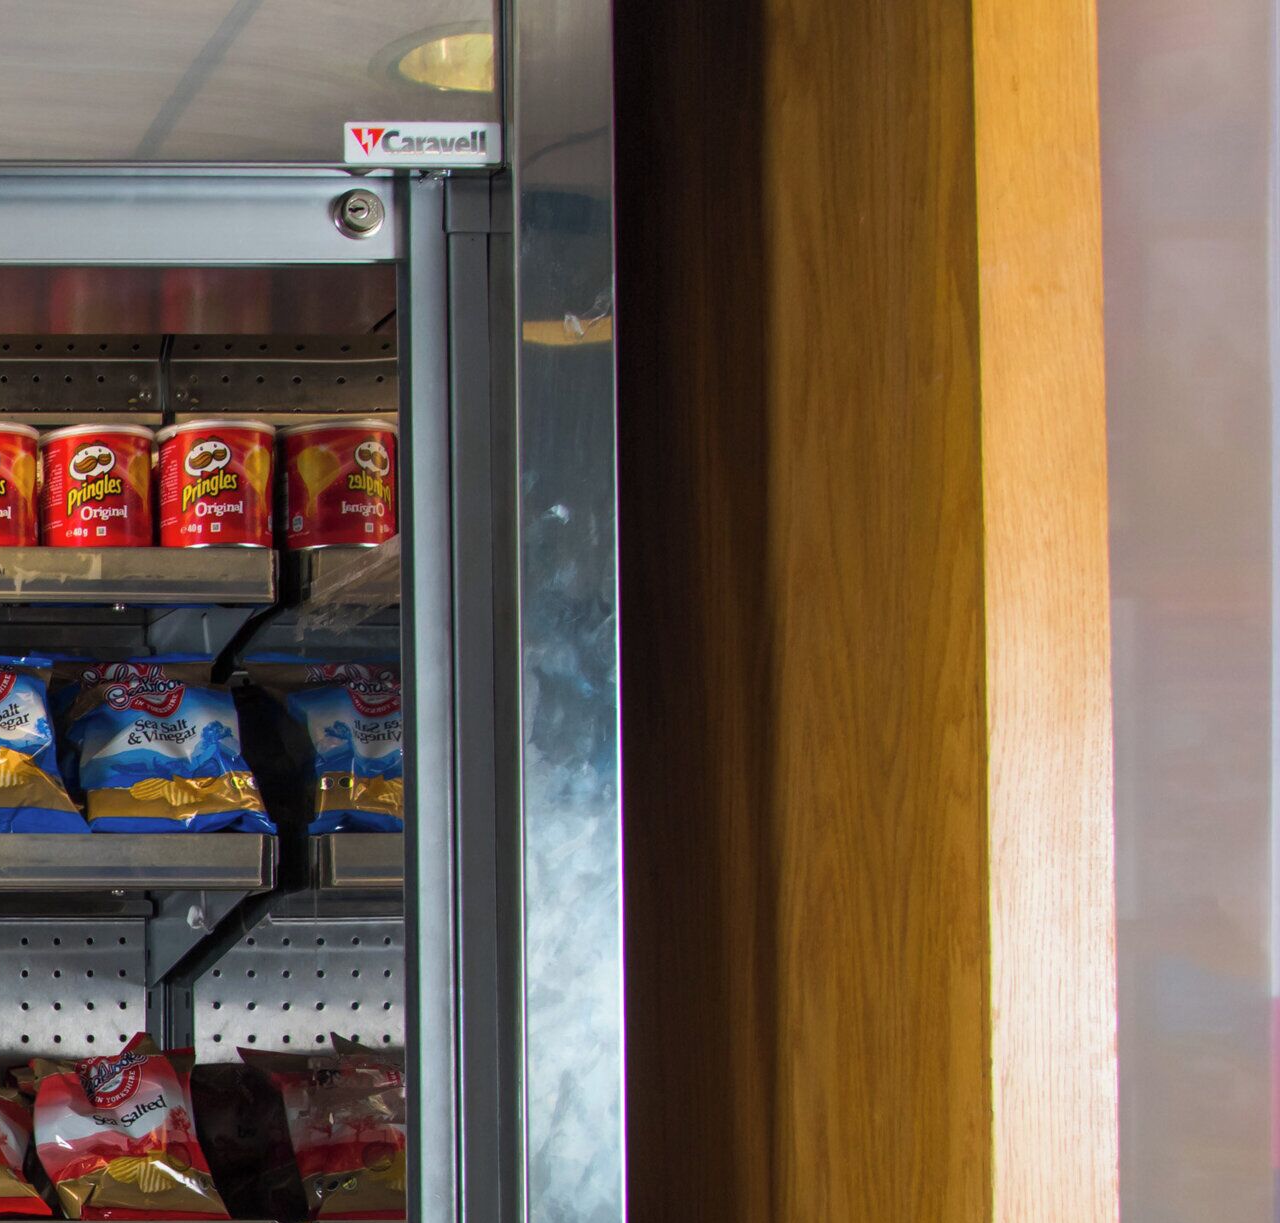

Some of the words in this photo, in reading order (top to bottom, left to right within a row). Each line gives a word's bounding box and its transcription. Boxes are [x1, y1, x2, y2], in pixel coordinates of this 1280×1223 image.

[381, 130, 486, 155] Caravell
[67, 475, 122, 516] Pringles
[182, 469, 238, 512] Pringles
[80, 504, 128, 521] Original
[195, 500, 244, 518] Original
[127, 731, 142, 745] &
[144, 724, 197, 743] Vinegar
[134, 719, 156, 732] Sea
[160, 719, 188, 734] Salt
[106, 1071, 136, 1104] YORKSHIRE
[92, 1114, 119, 1127] Sea
[122, 1095, 167, 1128] Salted
